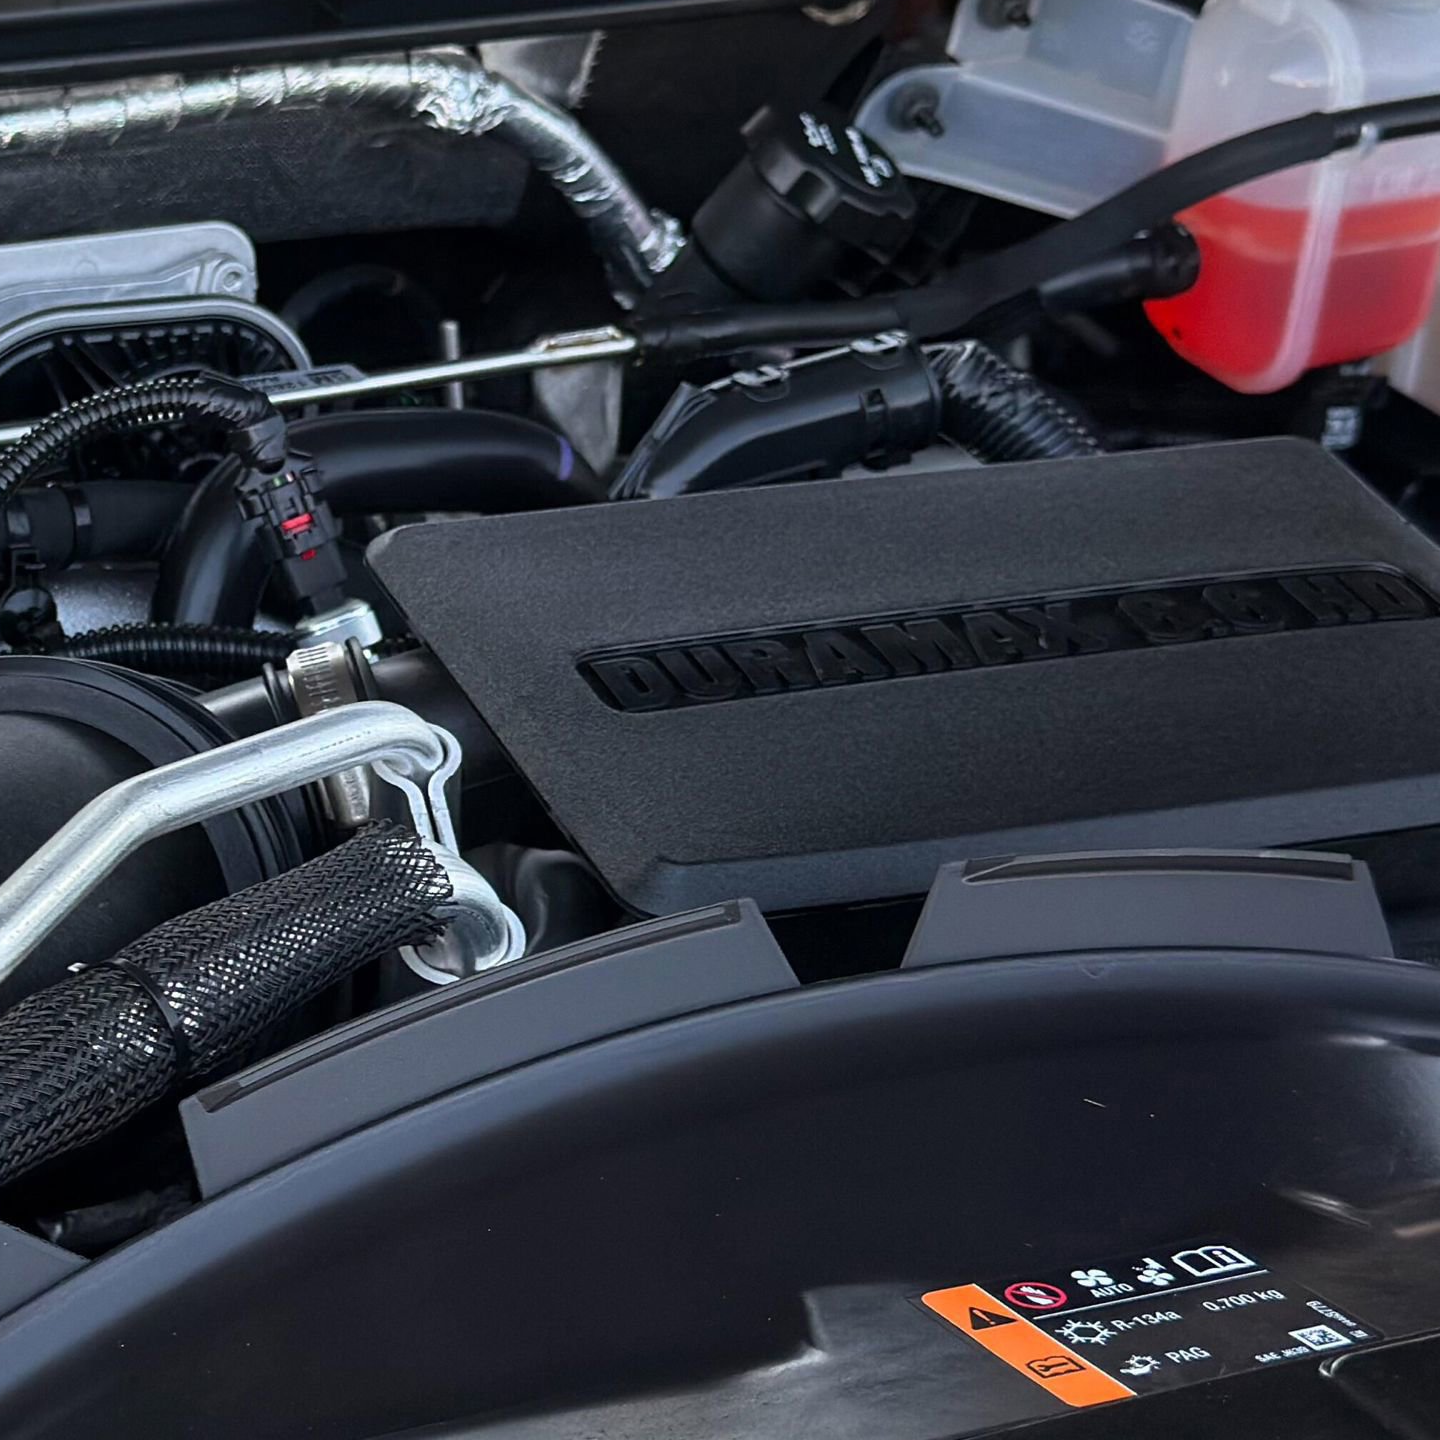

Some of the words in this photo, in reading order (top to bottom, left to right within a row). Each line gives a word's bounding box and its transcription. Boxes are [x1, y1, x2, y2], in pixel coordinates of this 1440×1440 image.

[590, 602, 1090, 711] DURAMAX
[1280, 571, 1432, 627] HD
[1090, 1283, 1135, 1298] AUTO
[1111, 1310, 1183, 1331] R-134a
[1202, 1293, 1256, 1311] 0.700
[1253, 1288, 1288, 1301] kg
[1165, 1346, 1211, 1363] PAG
